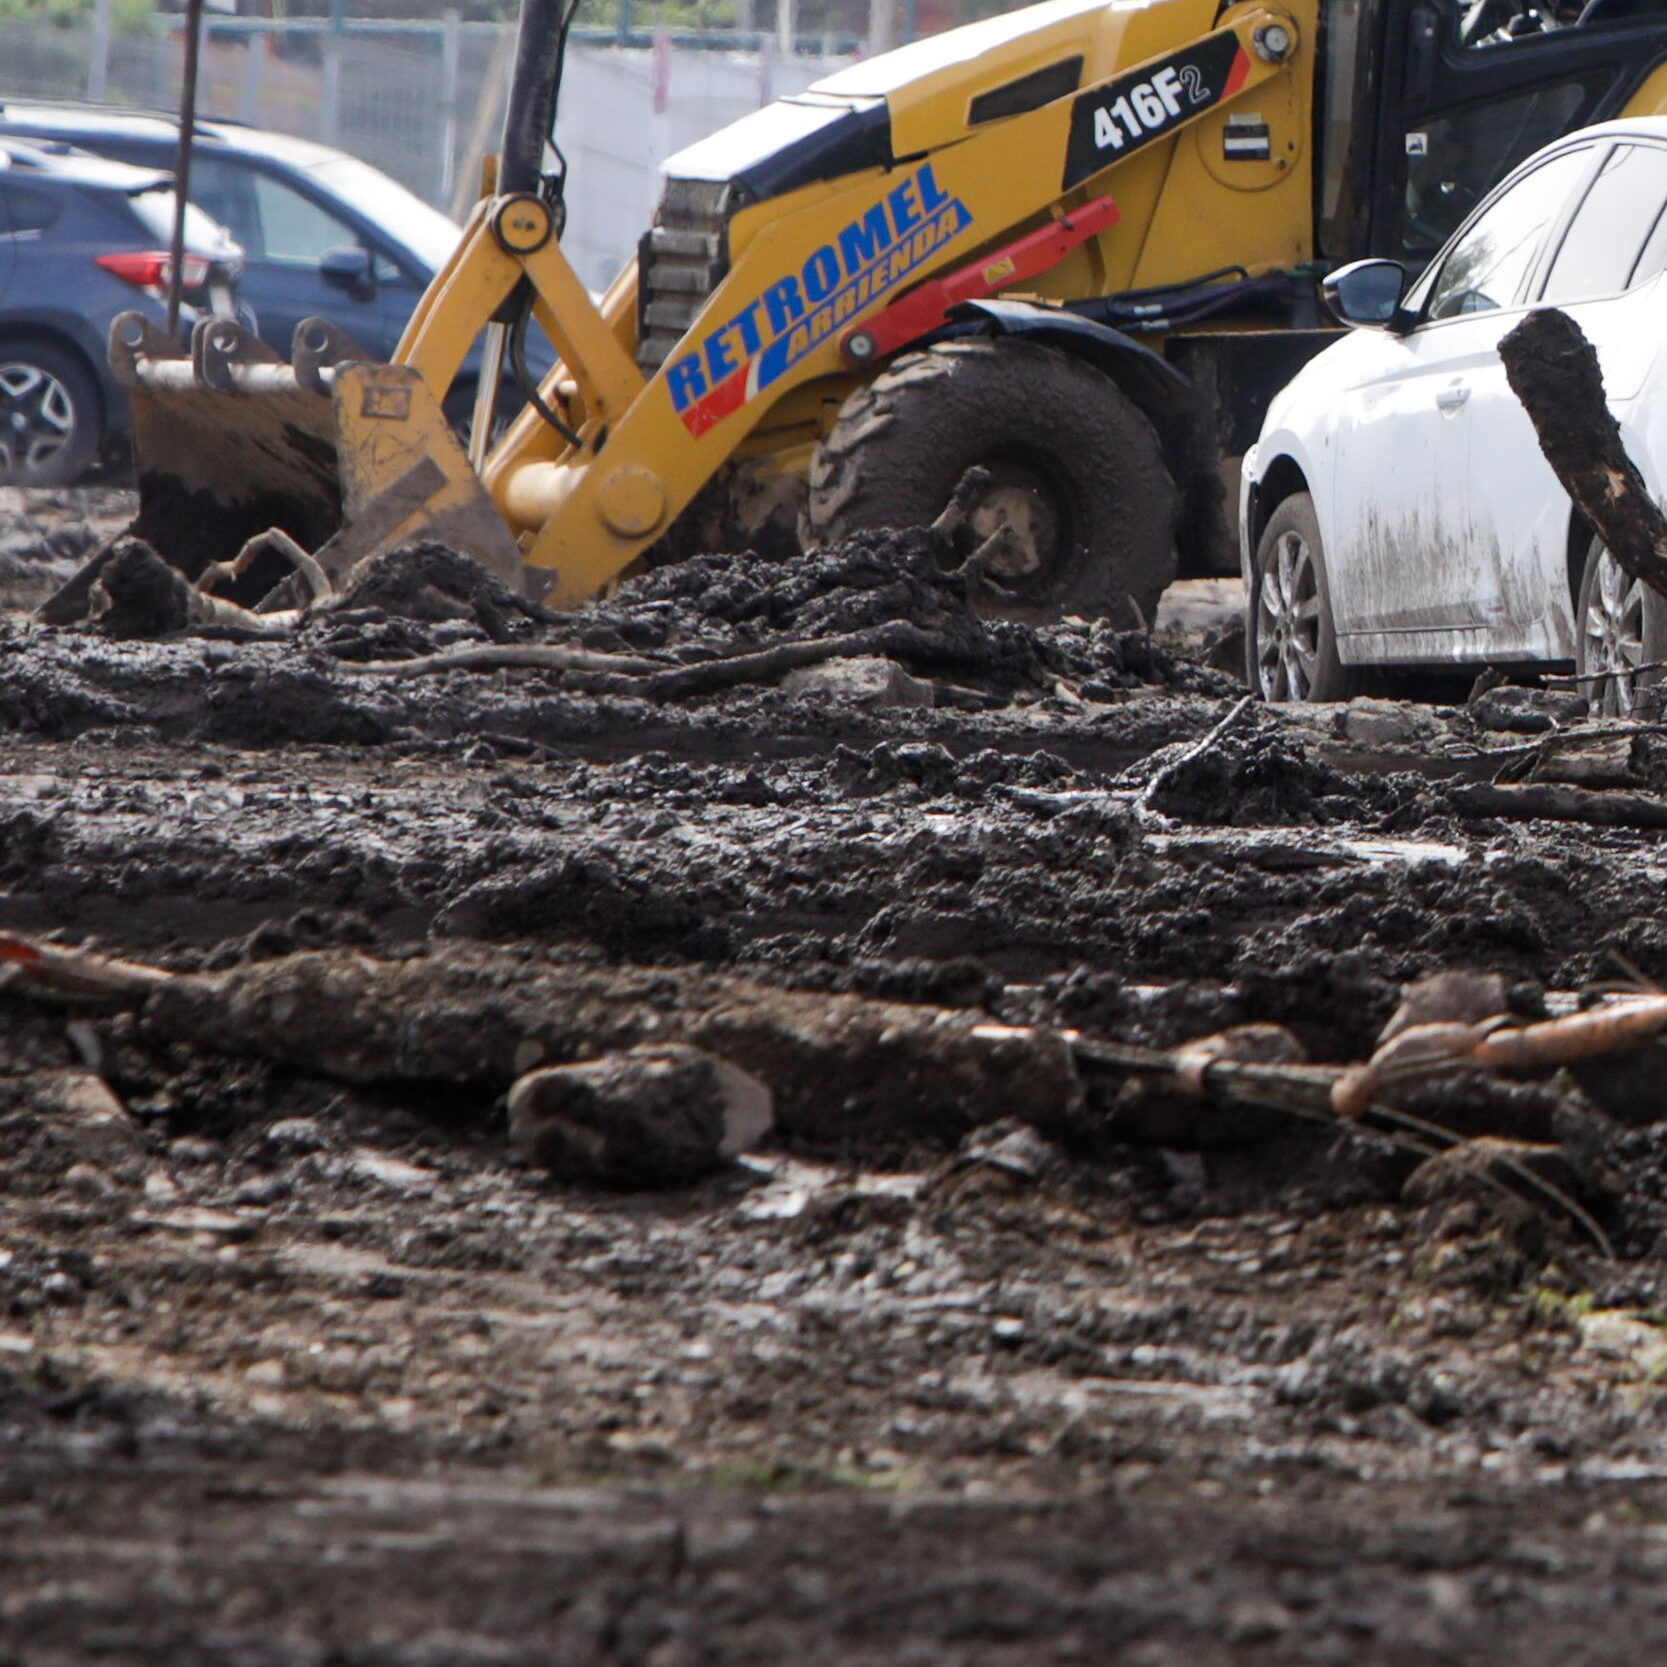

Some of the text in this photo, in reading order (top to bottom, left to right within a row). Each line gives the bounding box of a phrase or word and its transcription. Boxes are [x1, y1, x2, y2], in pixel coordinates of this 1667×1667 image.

[1093, 64, 1211, 150] 416F2
[665, 162, 949, 413] RETROMEL
[786, 203, 961, 360] ARRIENDA
